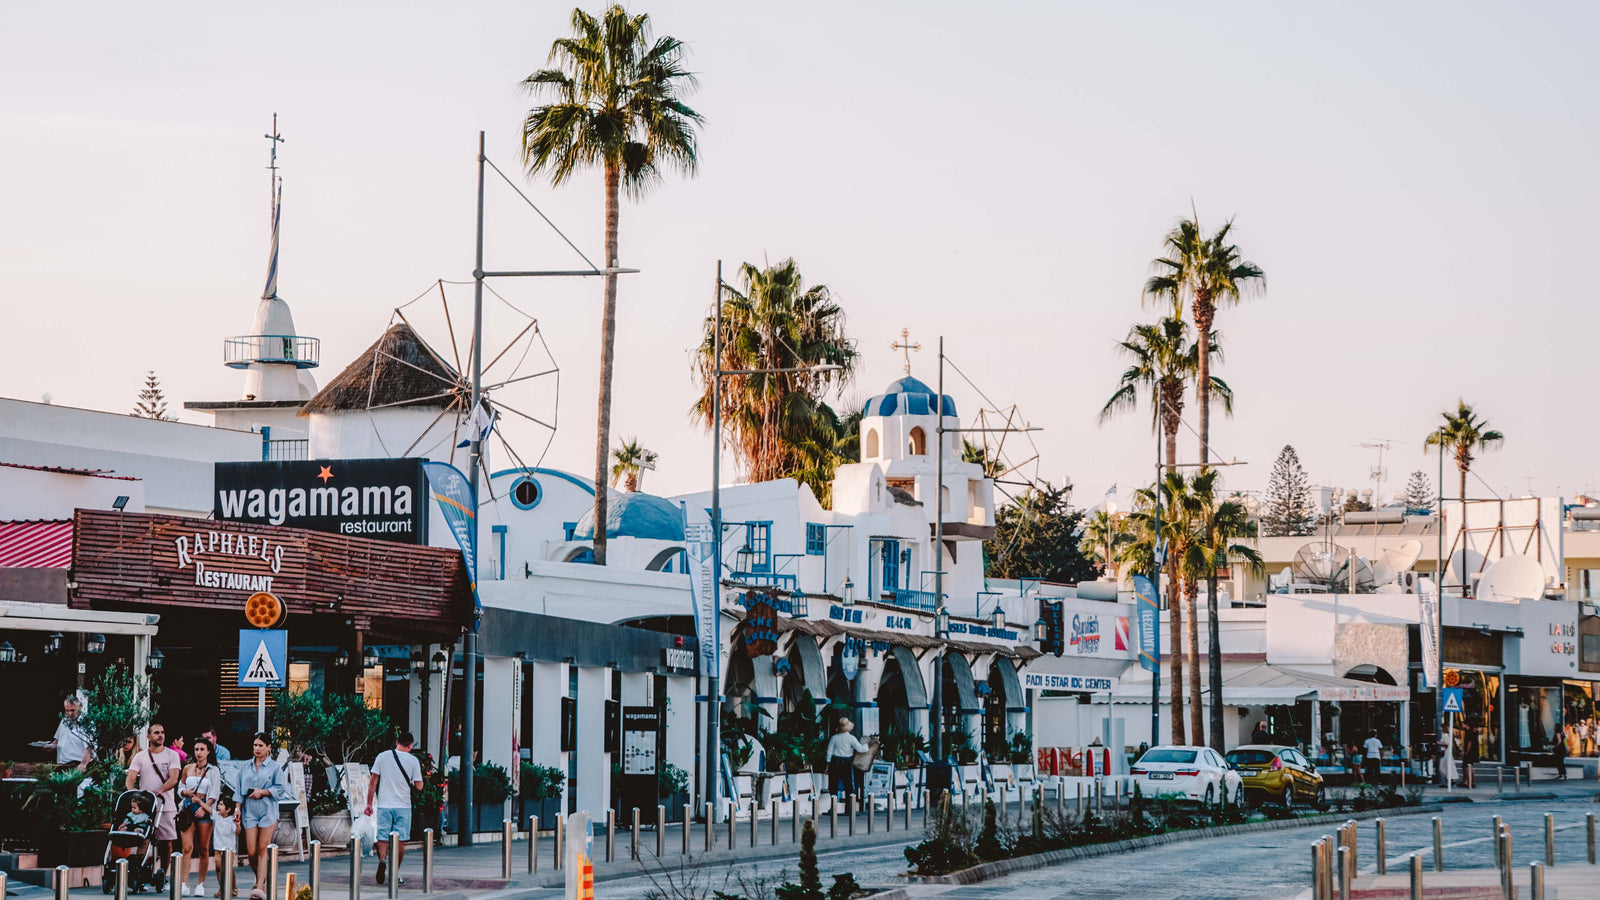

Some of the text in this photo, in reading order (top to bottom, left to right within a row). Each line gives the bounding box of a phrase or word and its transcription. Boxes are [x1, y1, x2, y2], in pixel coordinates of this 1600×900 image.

[219, 485, 412, 525] wagamama
[340, 518, 412, 533] restaurant
[175, 531, 284, 573] RAPHAELS
[195, 562, 274, 592] RESTAURANT
[748, 617, 773, 627] THE
[1026, 674, 1111, 689] PADI 5 STAR IDC CENTER
